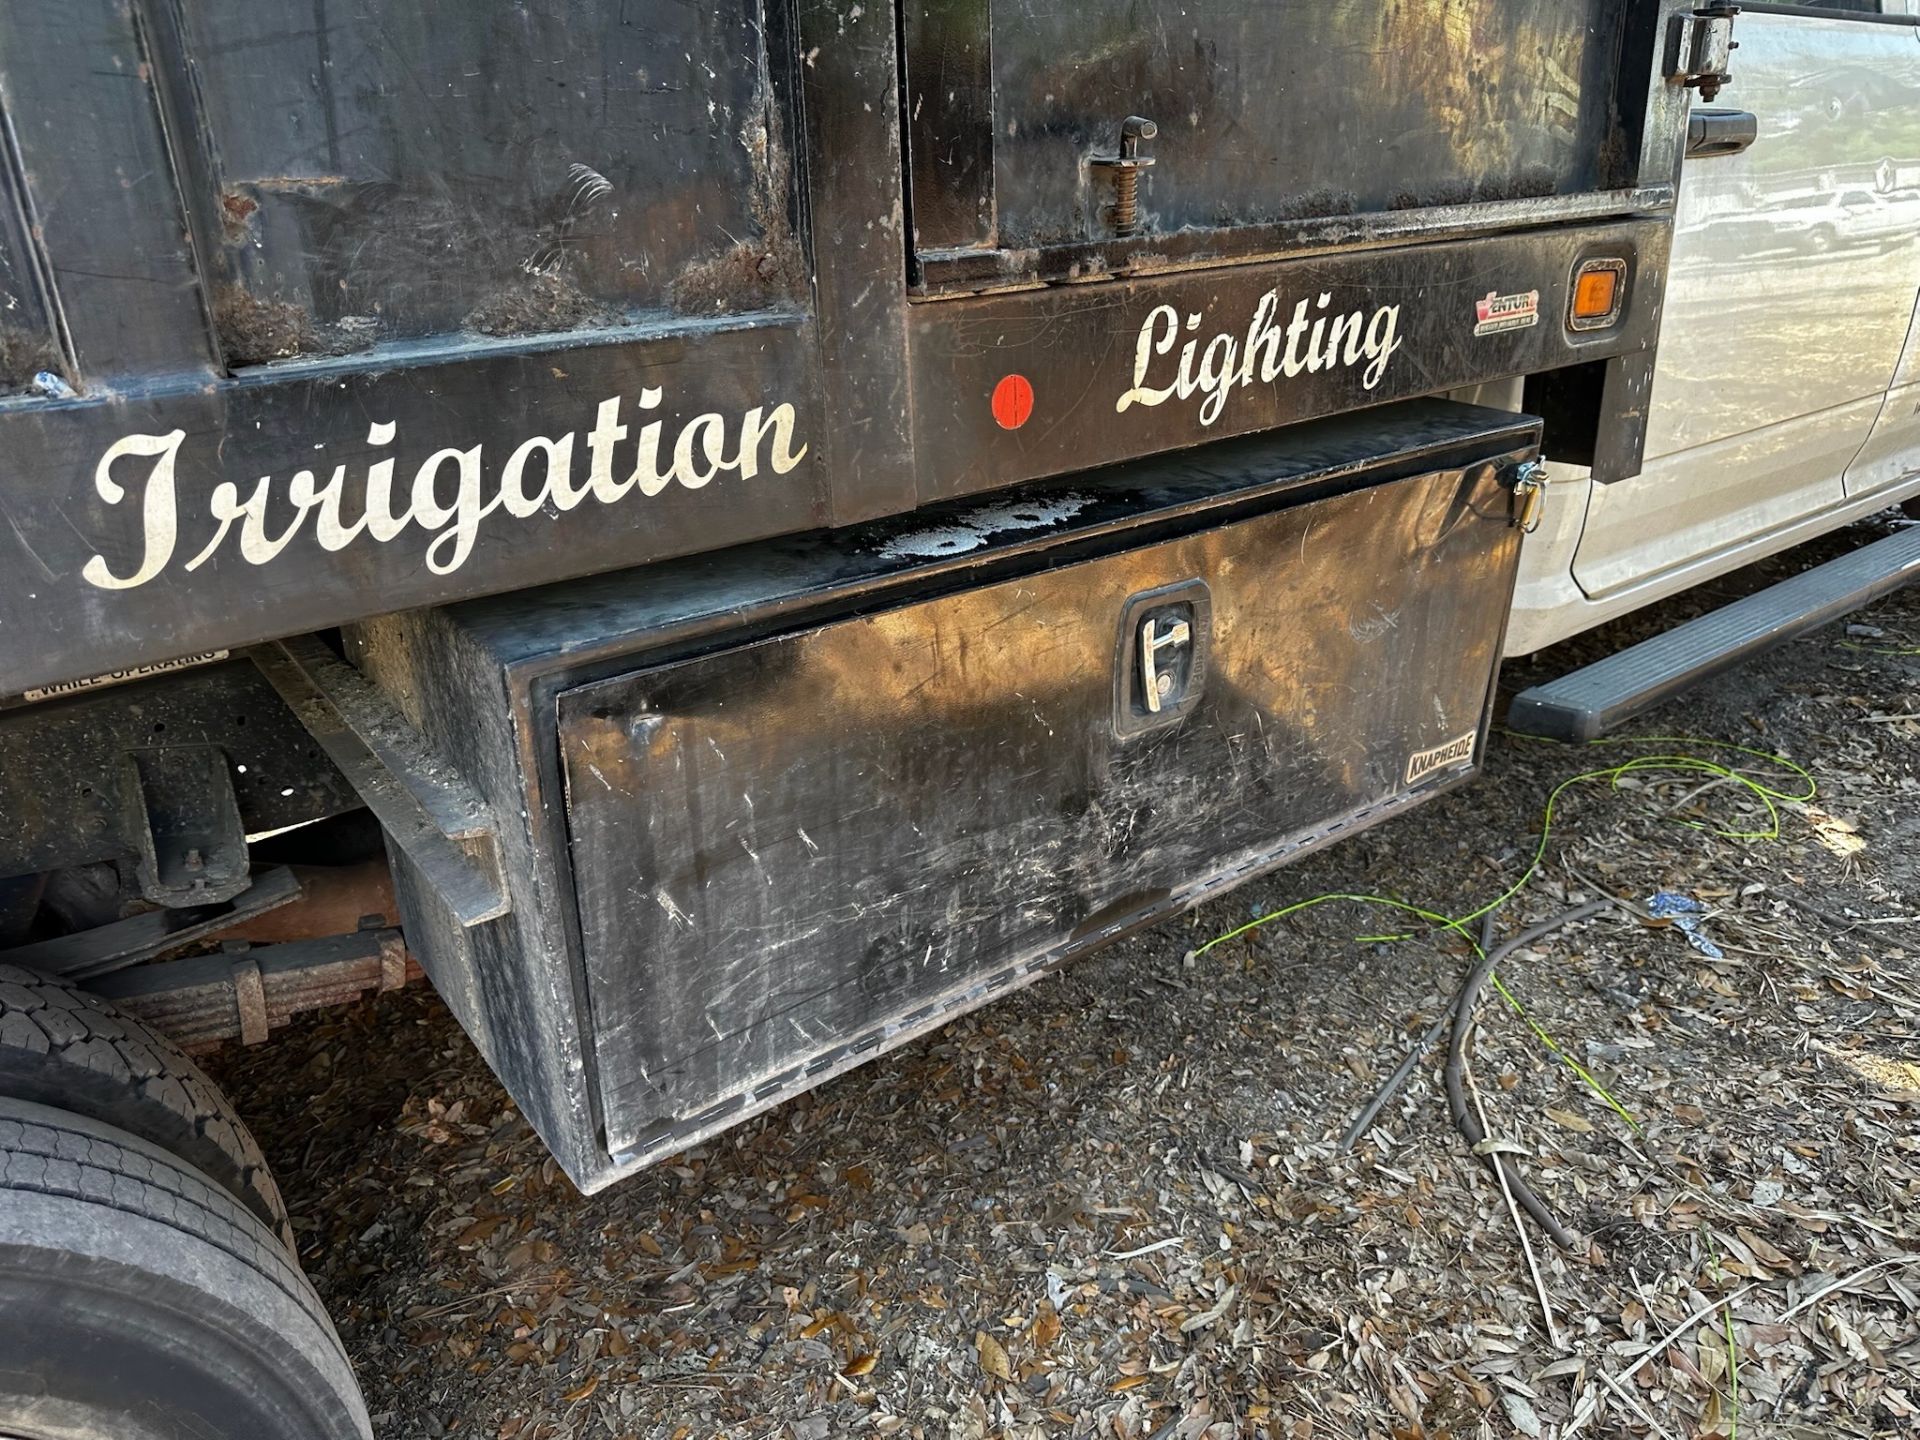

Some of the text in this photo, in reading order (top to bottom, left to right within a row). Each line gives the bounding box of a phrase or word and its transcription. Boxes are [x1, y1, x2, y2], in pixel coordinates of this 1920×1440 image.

[1116, 287, 1402, 426] Lighting
[82, 386, 808, 590] Irrigation
[1409, 734, 1473, 779] KNAPHEIDE
